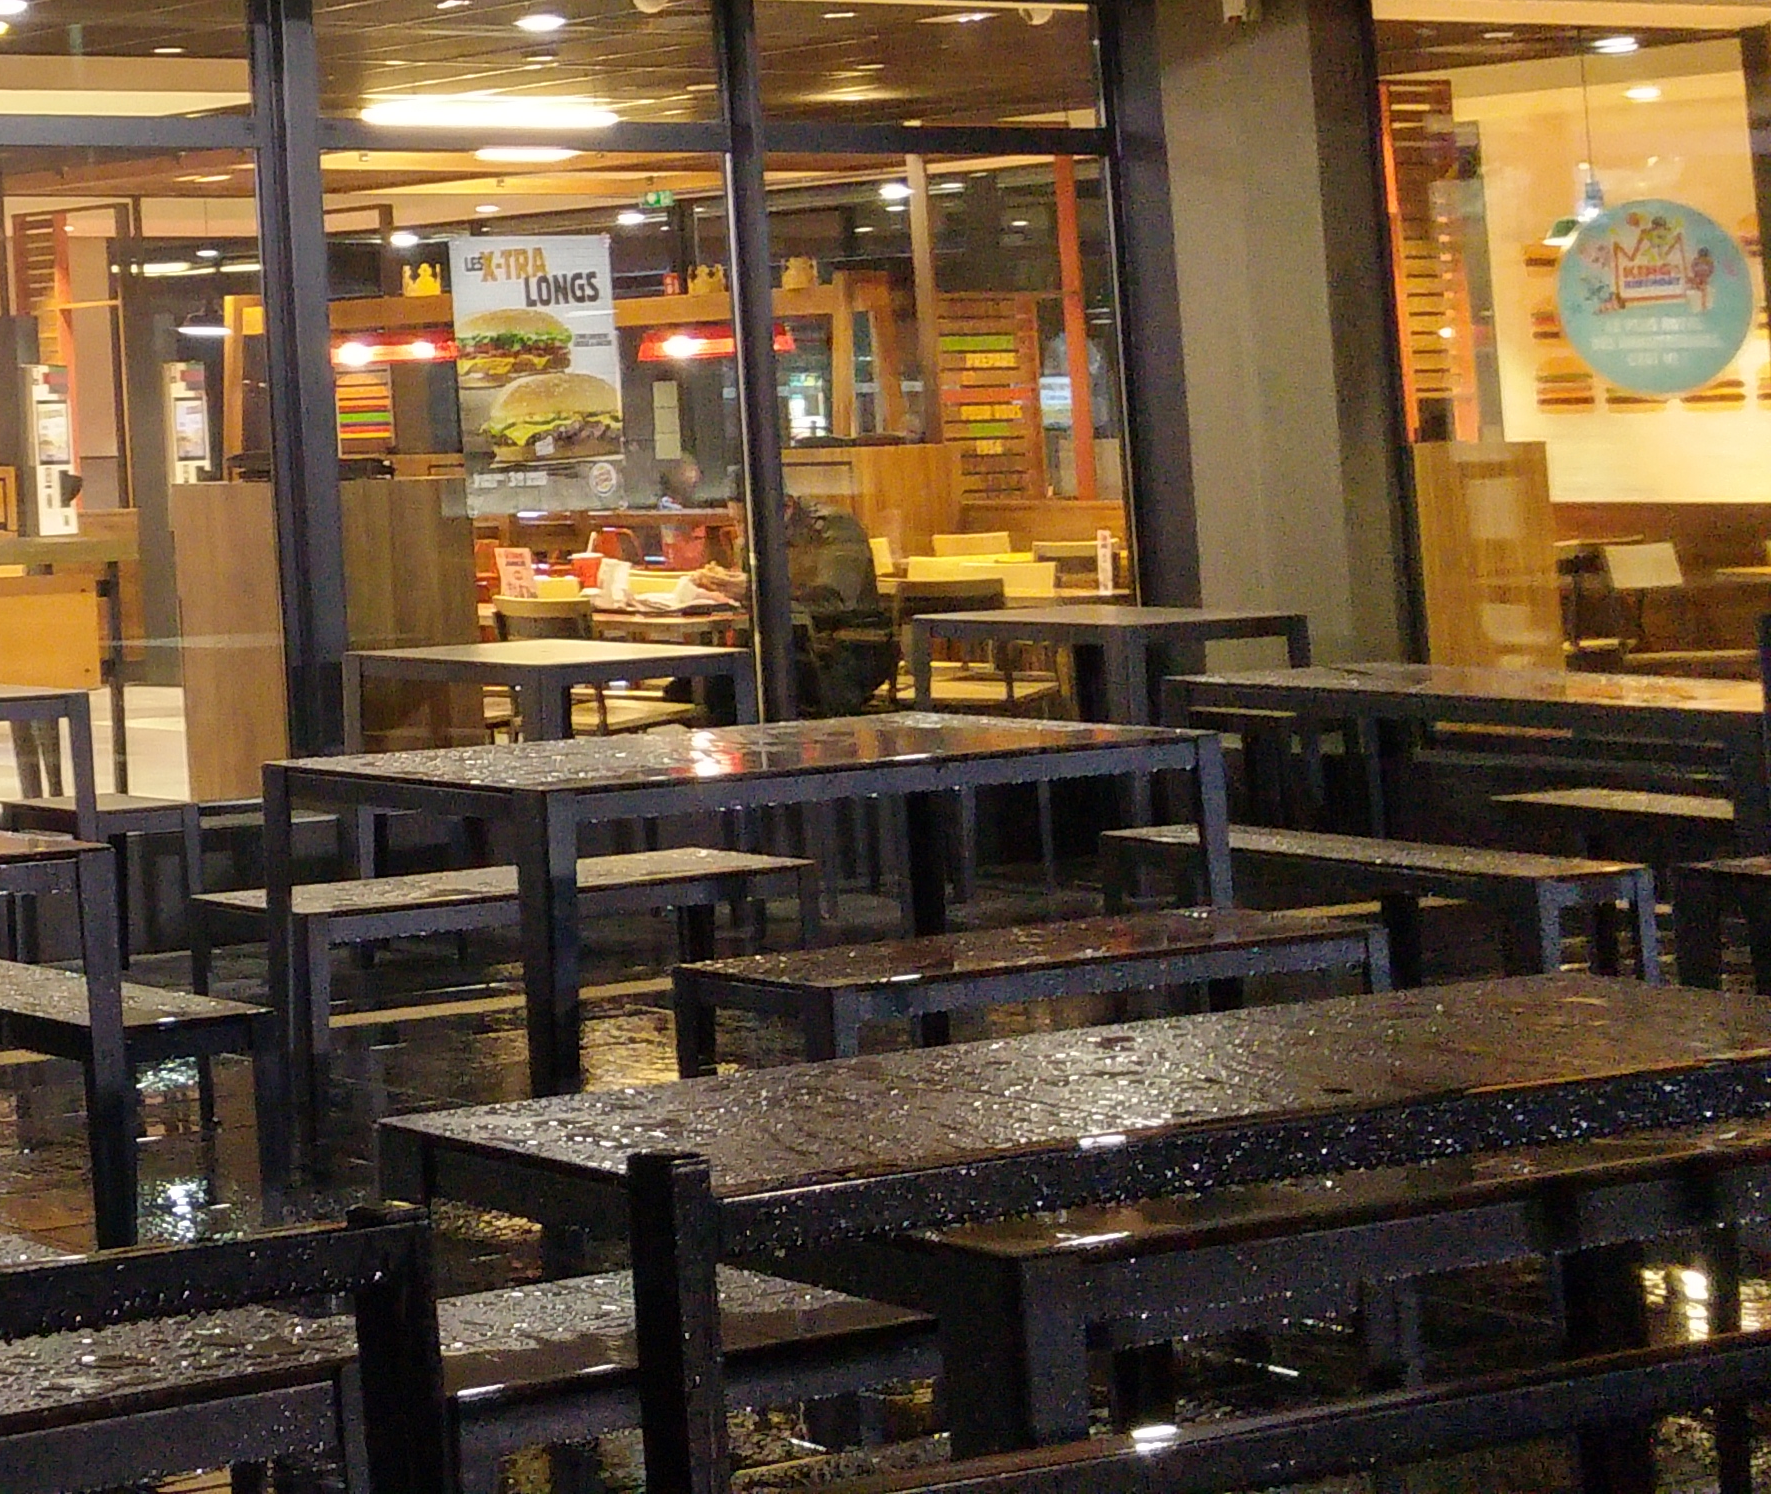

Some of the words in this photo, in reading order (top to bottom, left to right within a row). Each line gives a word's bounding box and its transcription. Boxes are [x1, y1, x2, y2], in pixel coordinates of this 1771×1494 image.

[464, 256, 483, 273] LES
[478, 246, 549, 283] X-TRA
[523, 270, 600, 307] LONGS
